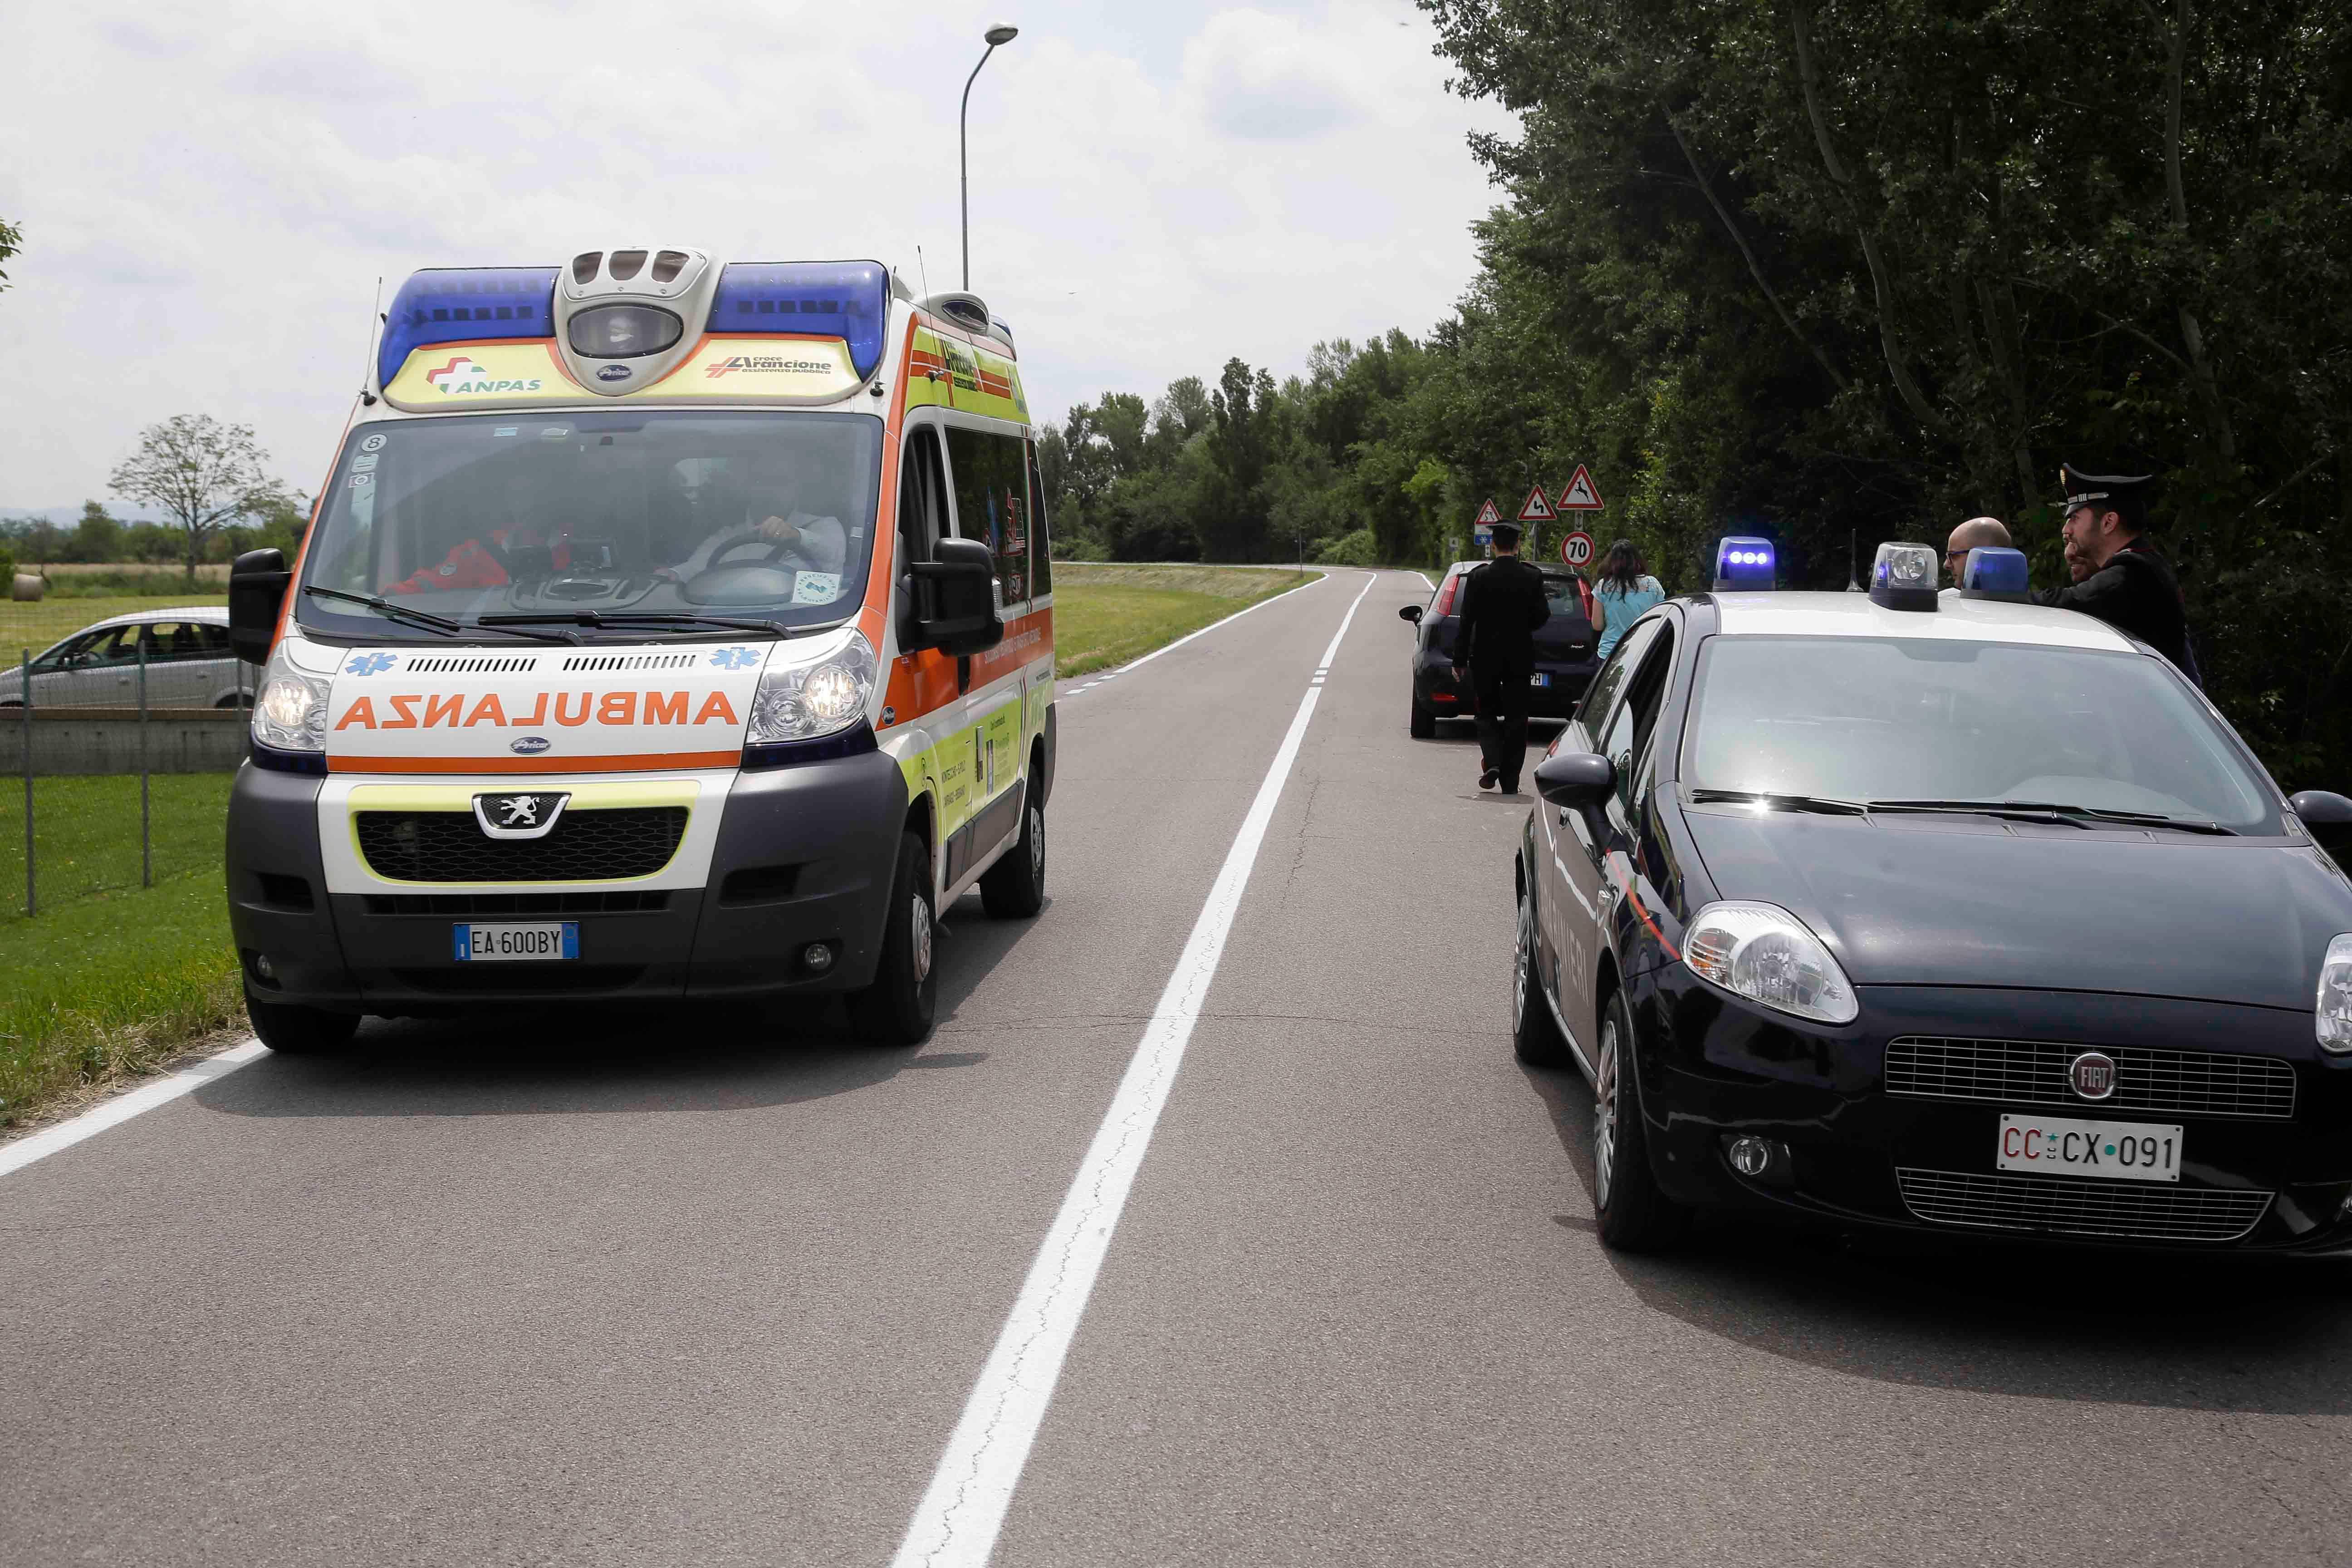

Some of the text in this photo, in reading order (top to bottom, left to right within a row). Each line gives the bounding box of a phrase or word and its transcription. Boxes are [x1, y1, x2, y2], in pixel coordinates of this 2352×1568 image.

[726, 357, 832, 370] Arancione
[455, 379, 541, 393] ANPAS
[1570, 541, 1587, 558] 70
[2080, 1066, 2109, 1088] FIAT
